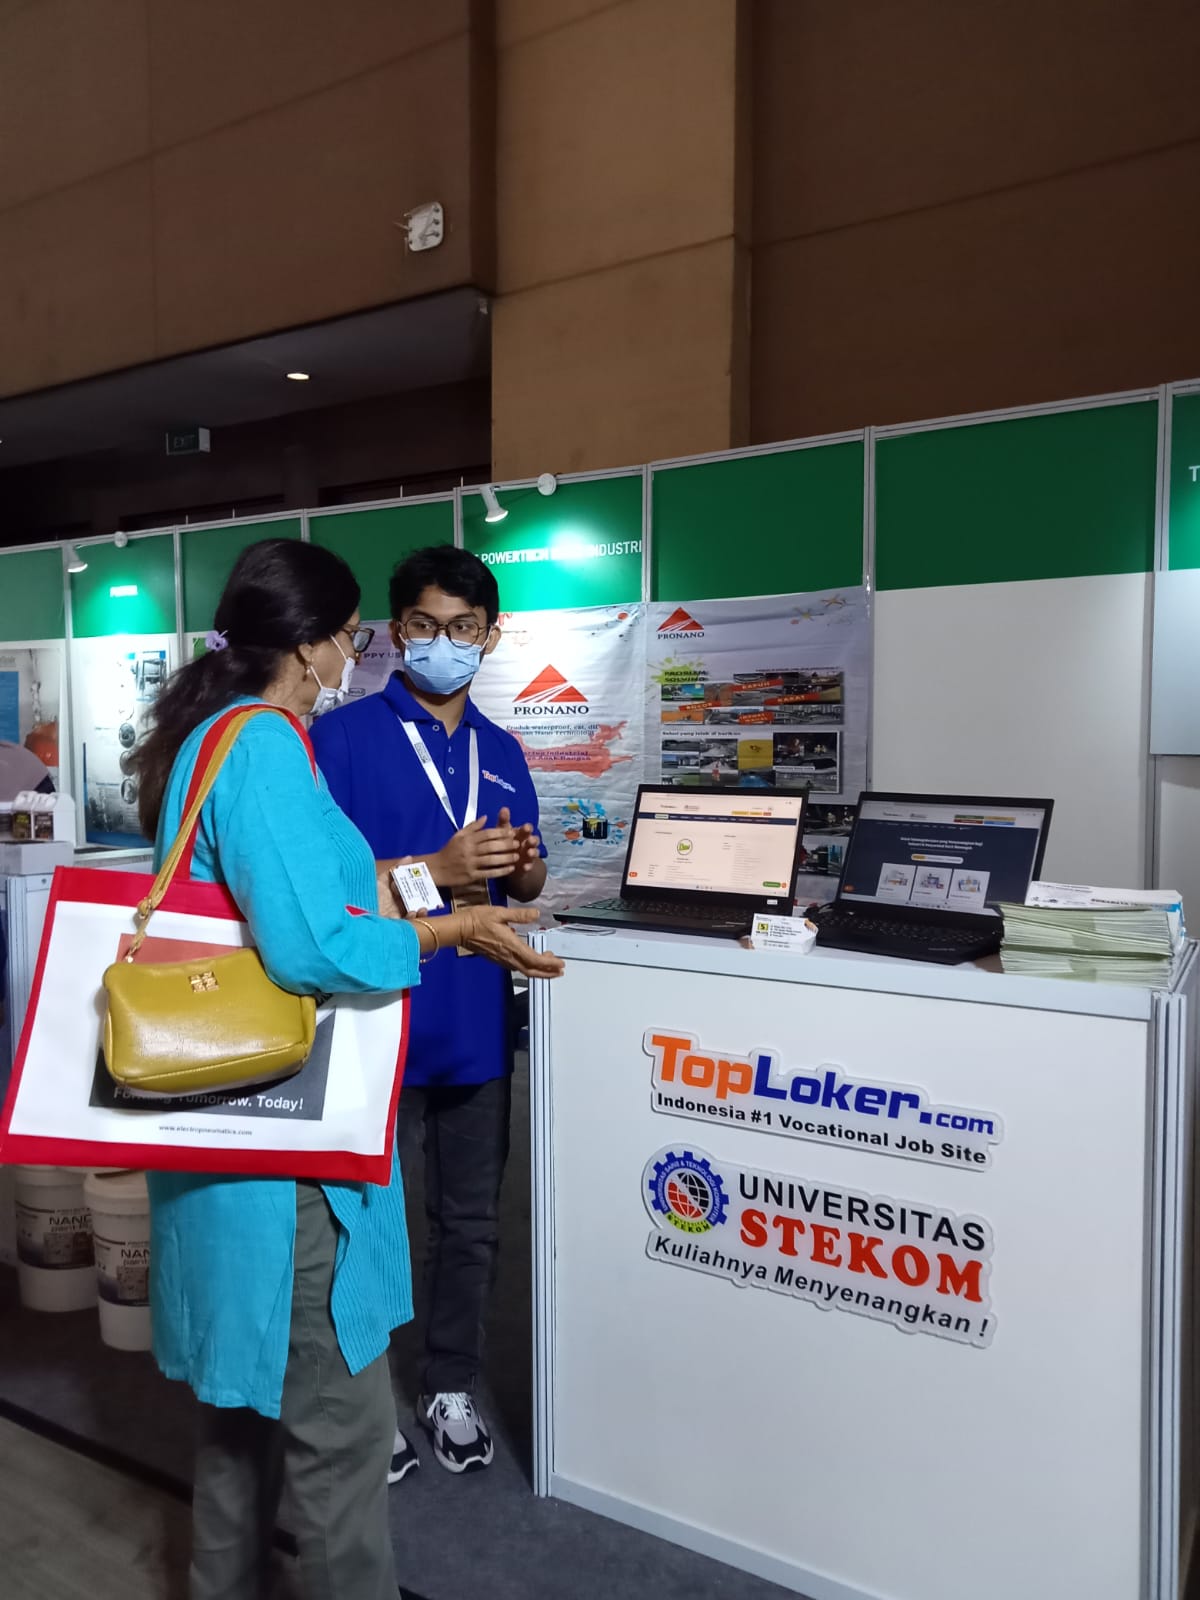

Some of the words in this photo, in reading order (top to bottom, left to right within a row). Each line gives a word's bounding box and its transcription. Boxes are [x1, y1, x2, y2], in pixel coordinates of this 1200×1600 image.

[481, 547, 549, 566] POWERTECH
[588, 540, 642, 558] NDUSTRI
[657, 631, 705, 640] PRONANO
[513, 705, 589, 715] PRONANO
[256, 1095, 304, 1112] Today!
[652, 1034, 994, 1135] TopLoker.com
[657, 1092, 746, 1122] Indonesia
[750, 1109, 772, 1126] #1
[779, 1114, 888, 1147] Vocational
[895, 1135, 934, 1155] Job
[941, 1143, 986, 1164] Site
[739, 1173, 985, 1251] UNIVERSITAS
[121, 1249, 151, 1259] NAN
[740, 1208, 984, 1303] STEKOM
[655, 1235, 768, 1280] Kuliahnya
[774, 1265, 971, 1334] Menyenangkan
